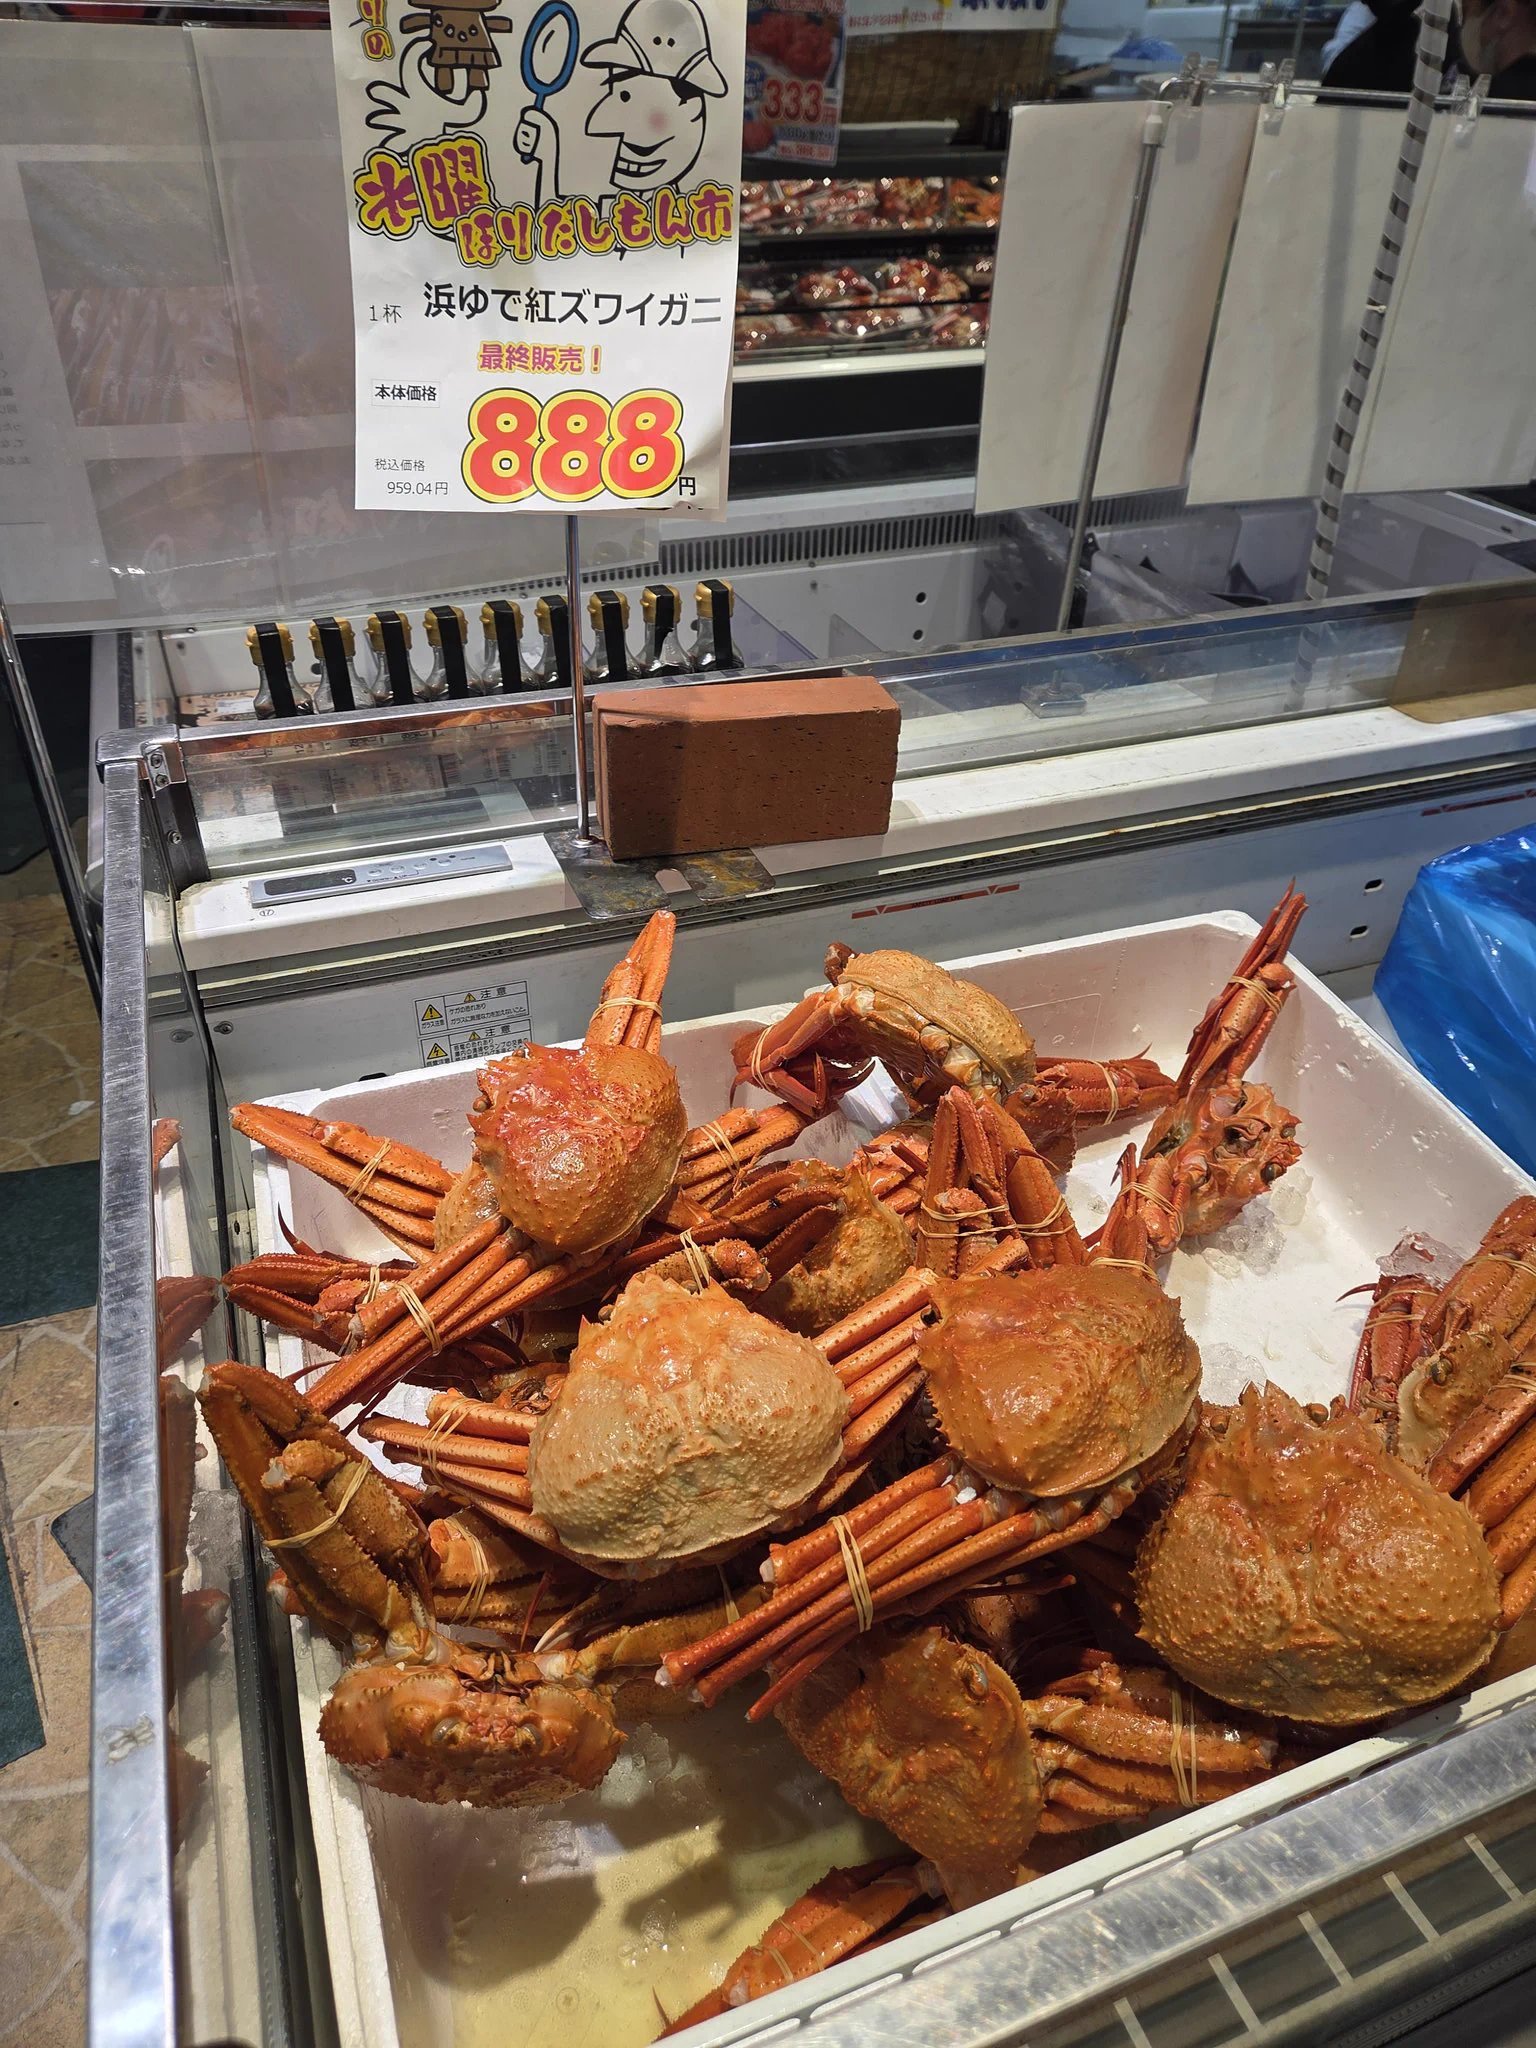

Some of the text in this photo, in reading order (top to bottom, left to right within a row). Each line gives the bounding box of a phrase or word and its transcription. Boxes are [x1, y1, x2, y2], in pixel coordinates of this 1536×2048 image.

[423, 282, 722, 327] 浜ゆで紅ズワイガニ
[369, 303, 402, 324] 1杯
[374, 383, 437, 402] 本体価格
[374, 458, 426, 472] 税込価格
[387, 481, 449, 496] 959.04円
[480, 986, 507, 999] 注意
[485, 1025, 511, 1037] 注意
